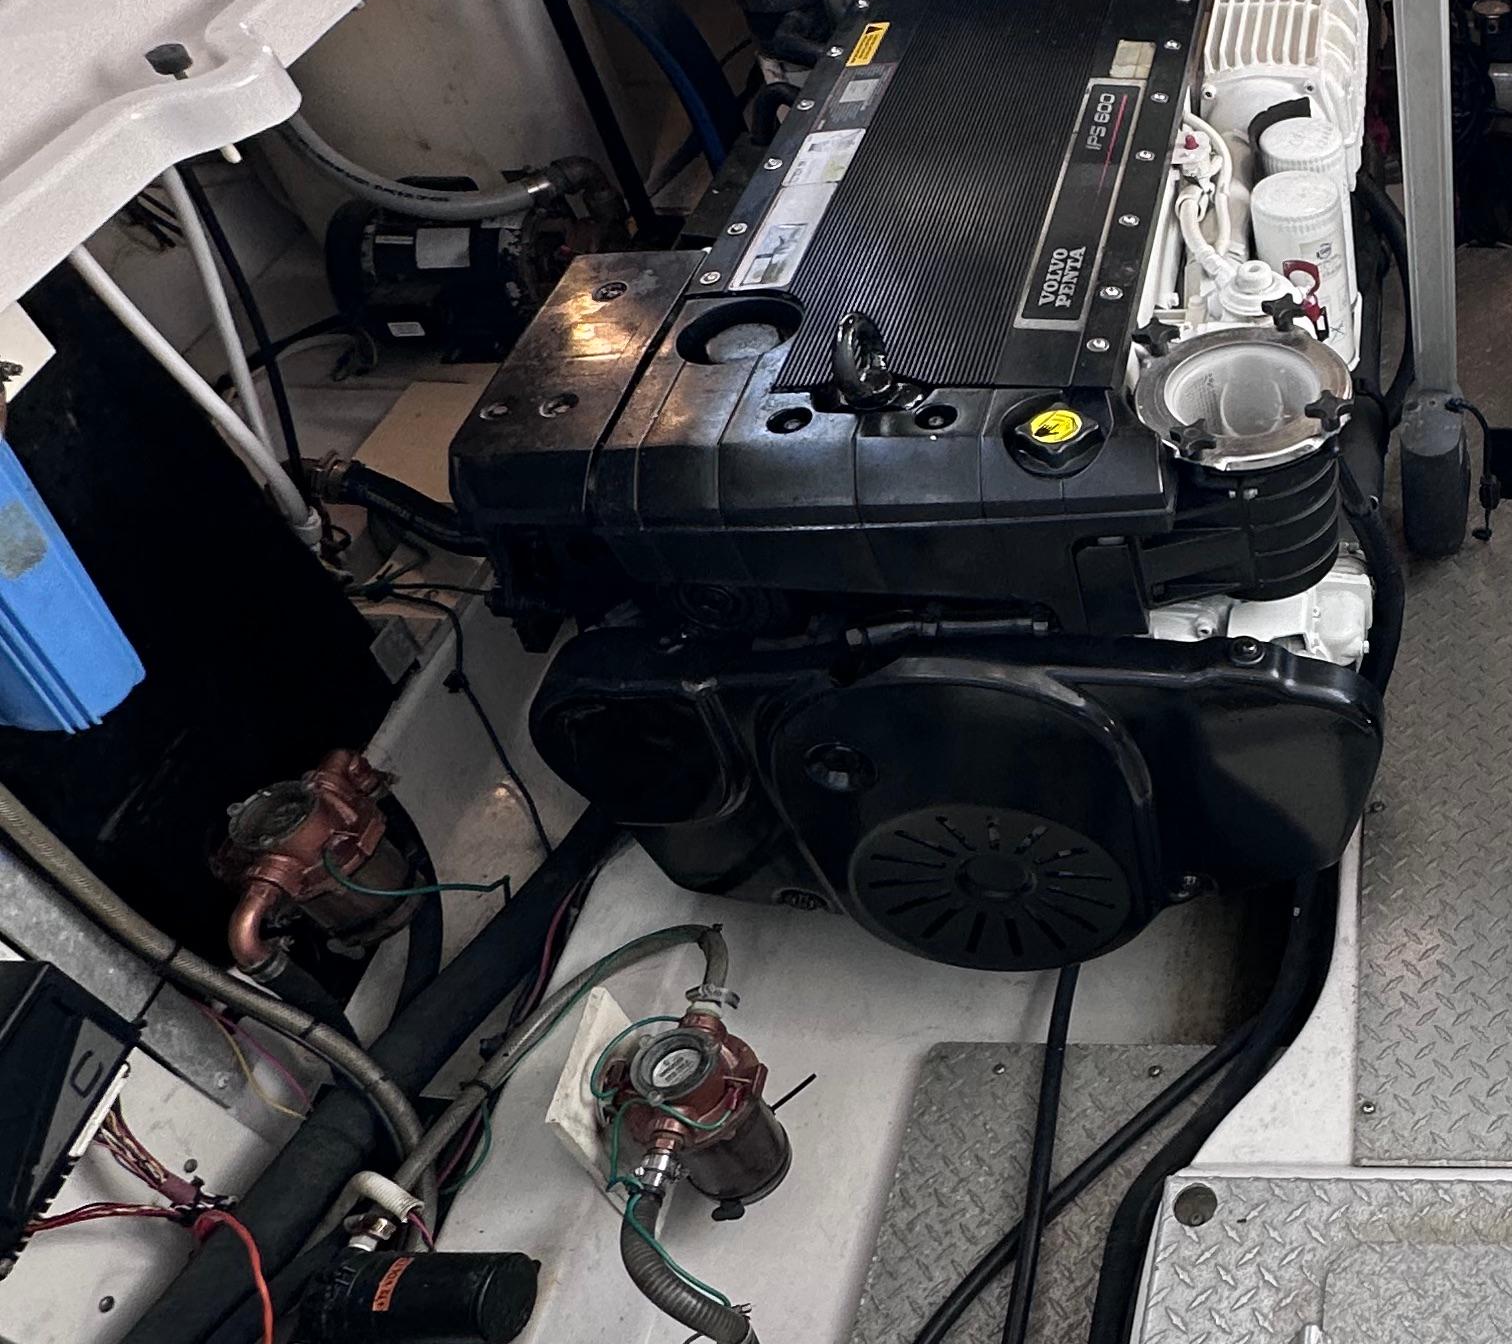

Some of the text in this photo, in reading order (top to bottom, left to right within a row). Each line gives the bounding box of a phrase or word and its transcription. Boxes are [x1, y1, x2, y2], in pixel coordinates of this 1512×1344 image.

[1085, 92, 1116, 151] IPS 600
[1038, 247, 1069, 307] VOLVO
[1055, 246, 1087, 308] PENTA
